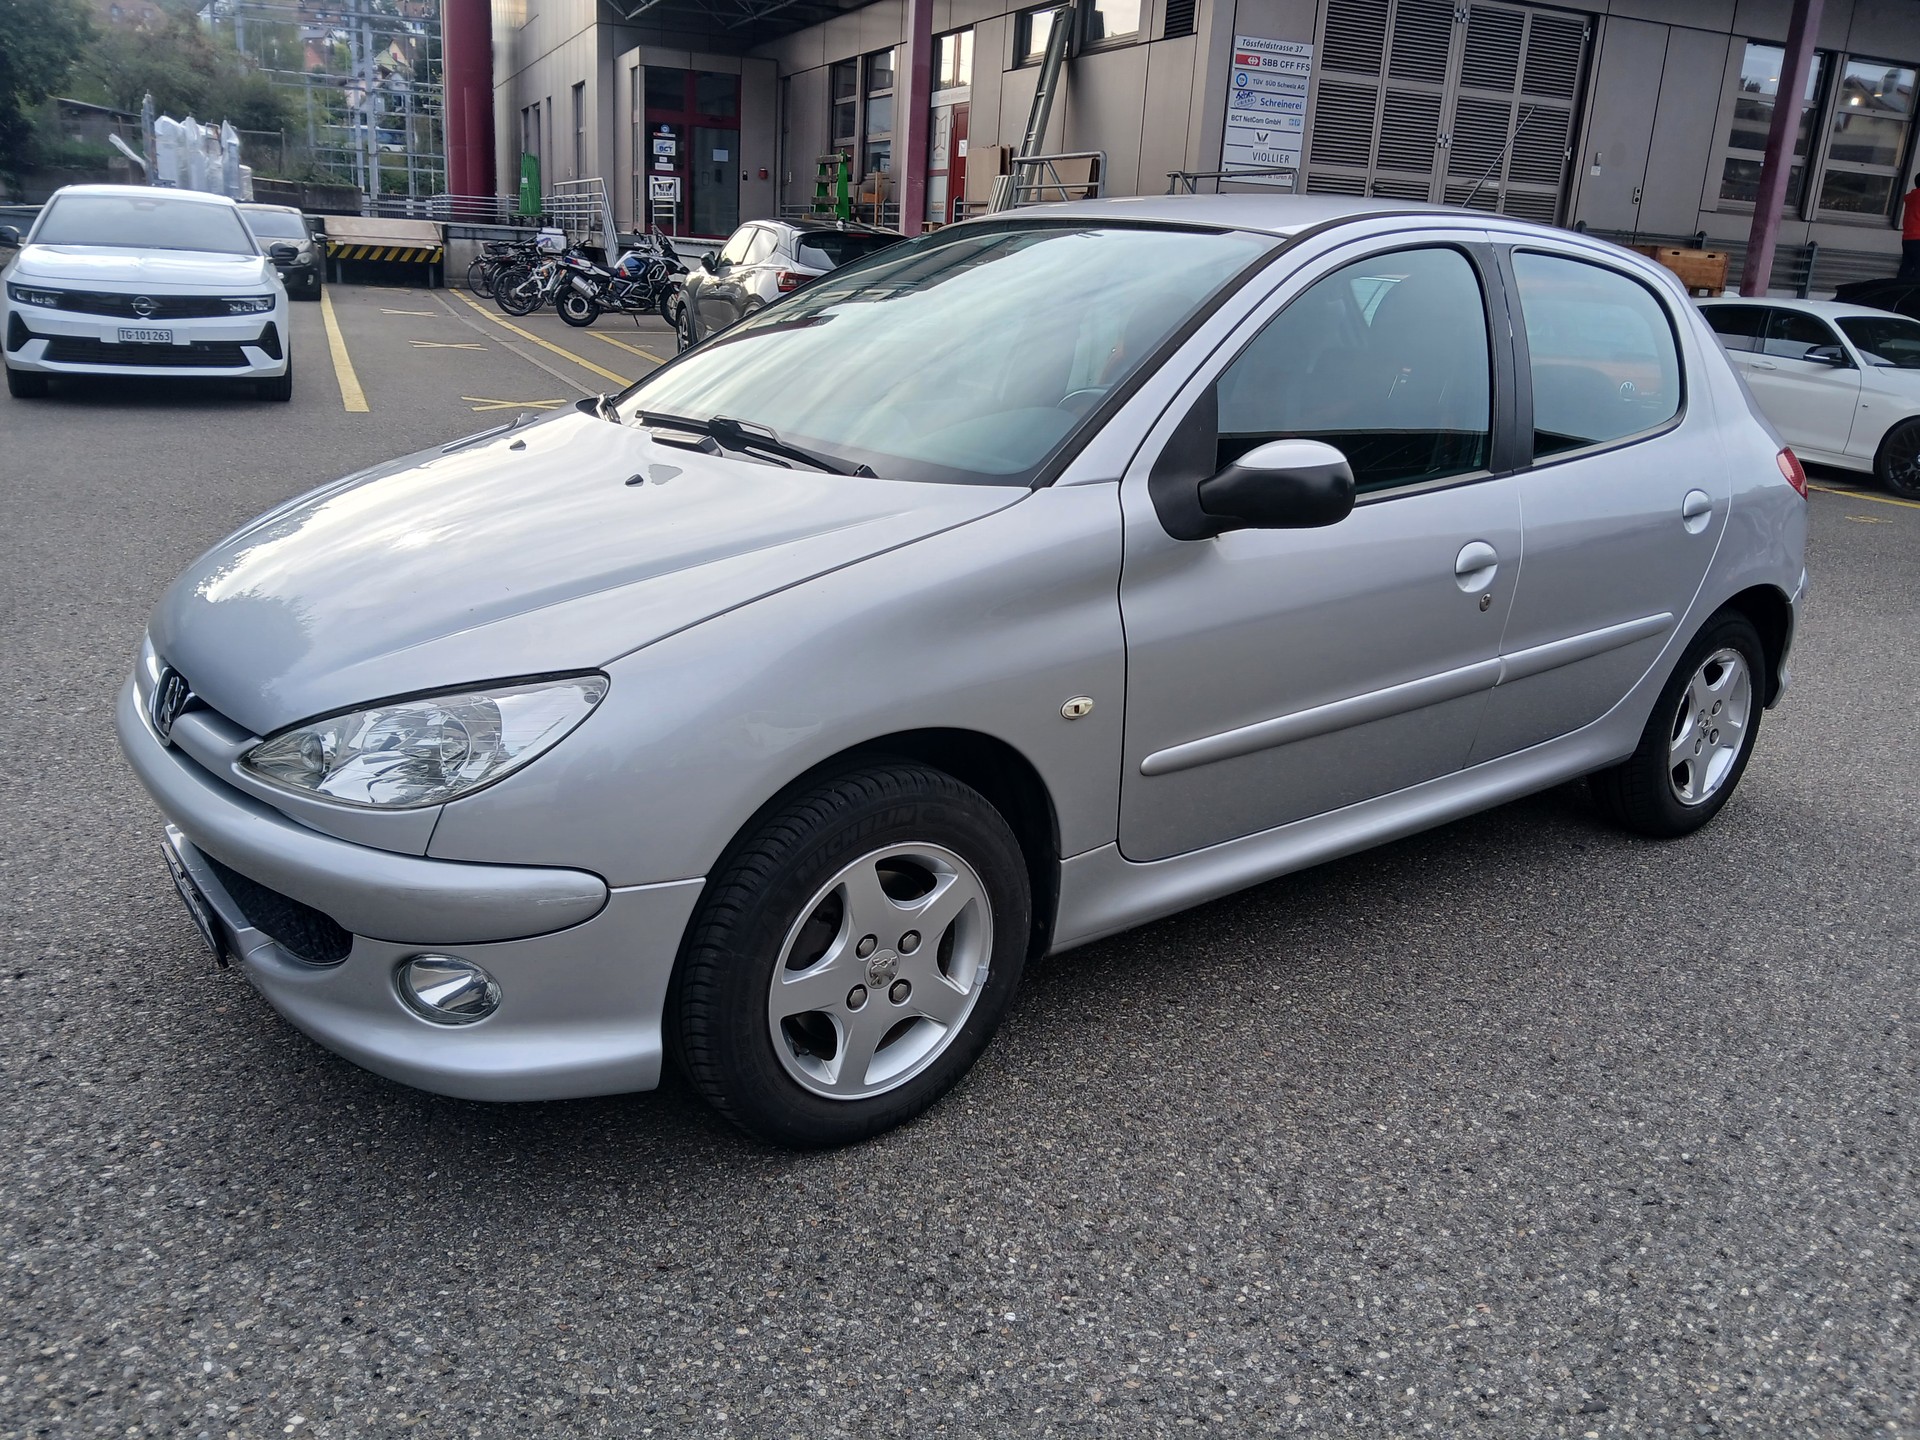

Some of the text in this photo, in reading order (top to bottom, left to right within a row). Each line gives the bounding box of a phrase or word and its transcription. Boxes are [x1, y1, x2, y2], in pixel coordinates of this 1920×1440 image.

[1242, 39, 1304, 53] Tössfeldstrasse 37
[1262, 58, 1311, 71] SBB CFF FFS
[1265, 79, 1276, 87] SÜD
[1277, 81, 1297, 89] Schweiz
[1260, 97, 1302, 110] Schreinerei
[1231, 114, 1282, 126] BCT NetCom GmbH
[1252, 151, 1290, 164] VIOLLIER
